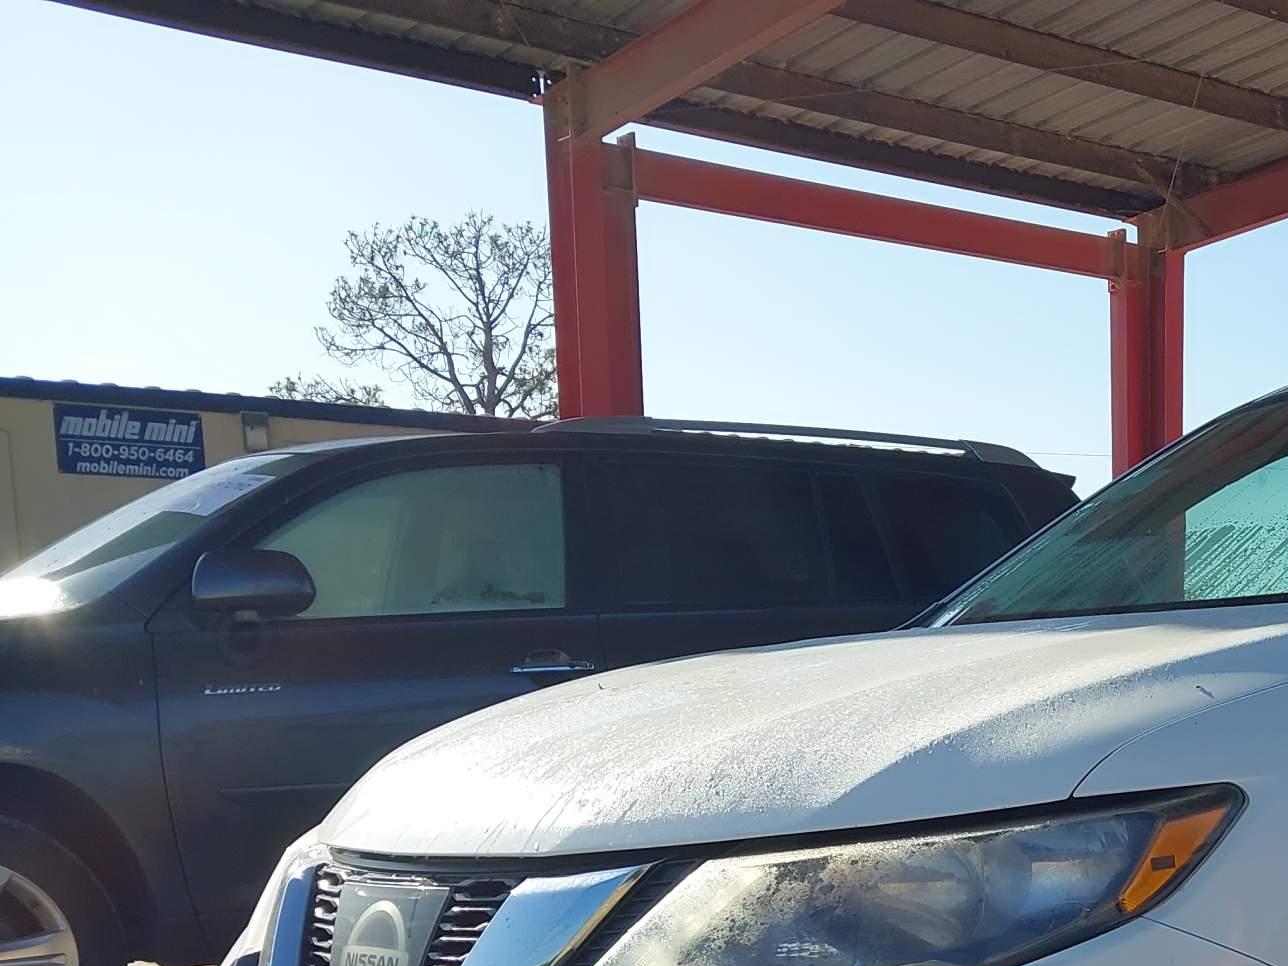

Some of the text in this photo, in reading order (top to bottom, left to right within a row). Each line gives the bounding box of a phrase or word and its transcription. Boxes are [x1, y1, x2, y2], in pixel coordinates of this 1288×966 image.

[60, 409, 197, 443] mobile mini
[67, 442, 194, 463] 1-800-950-6464
[76, 460, 190, 478] mobilemini.com
